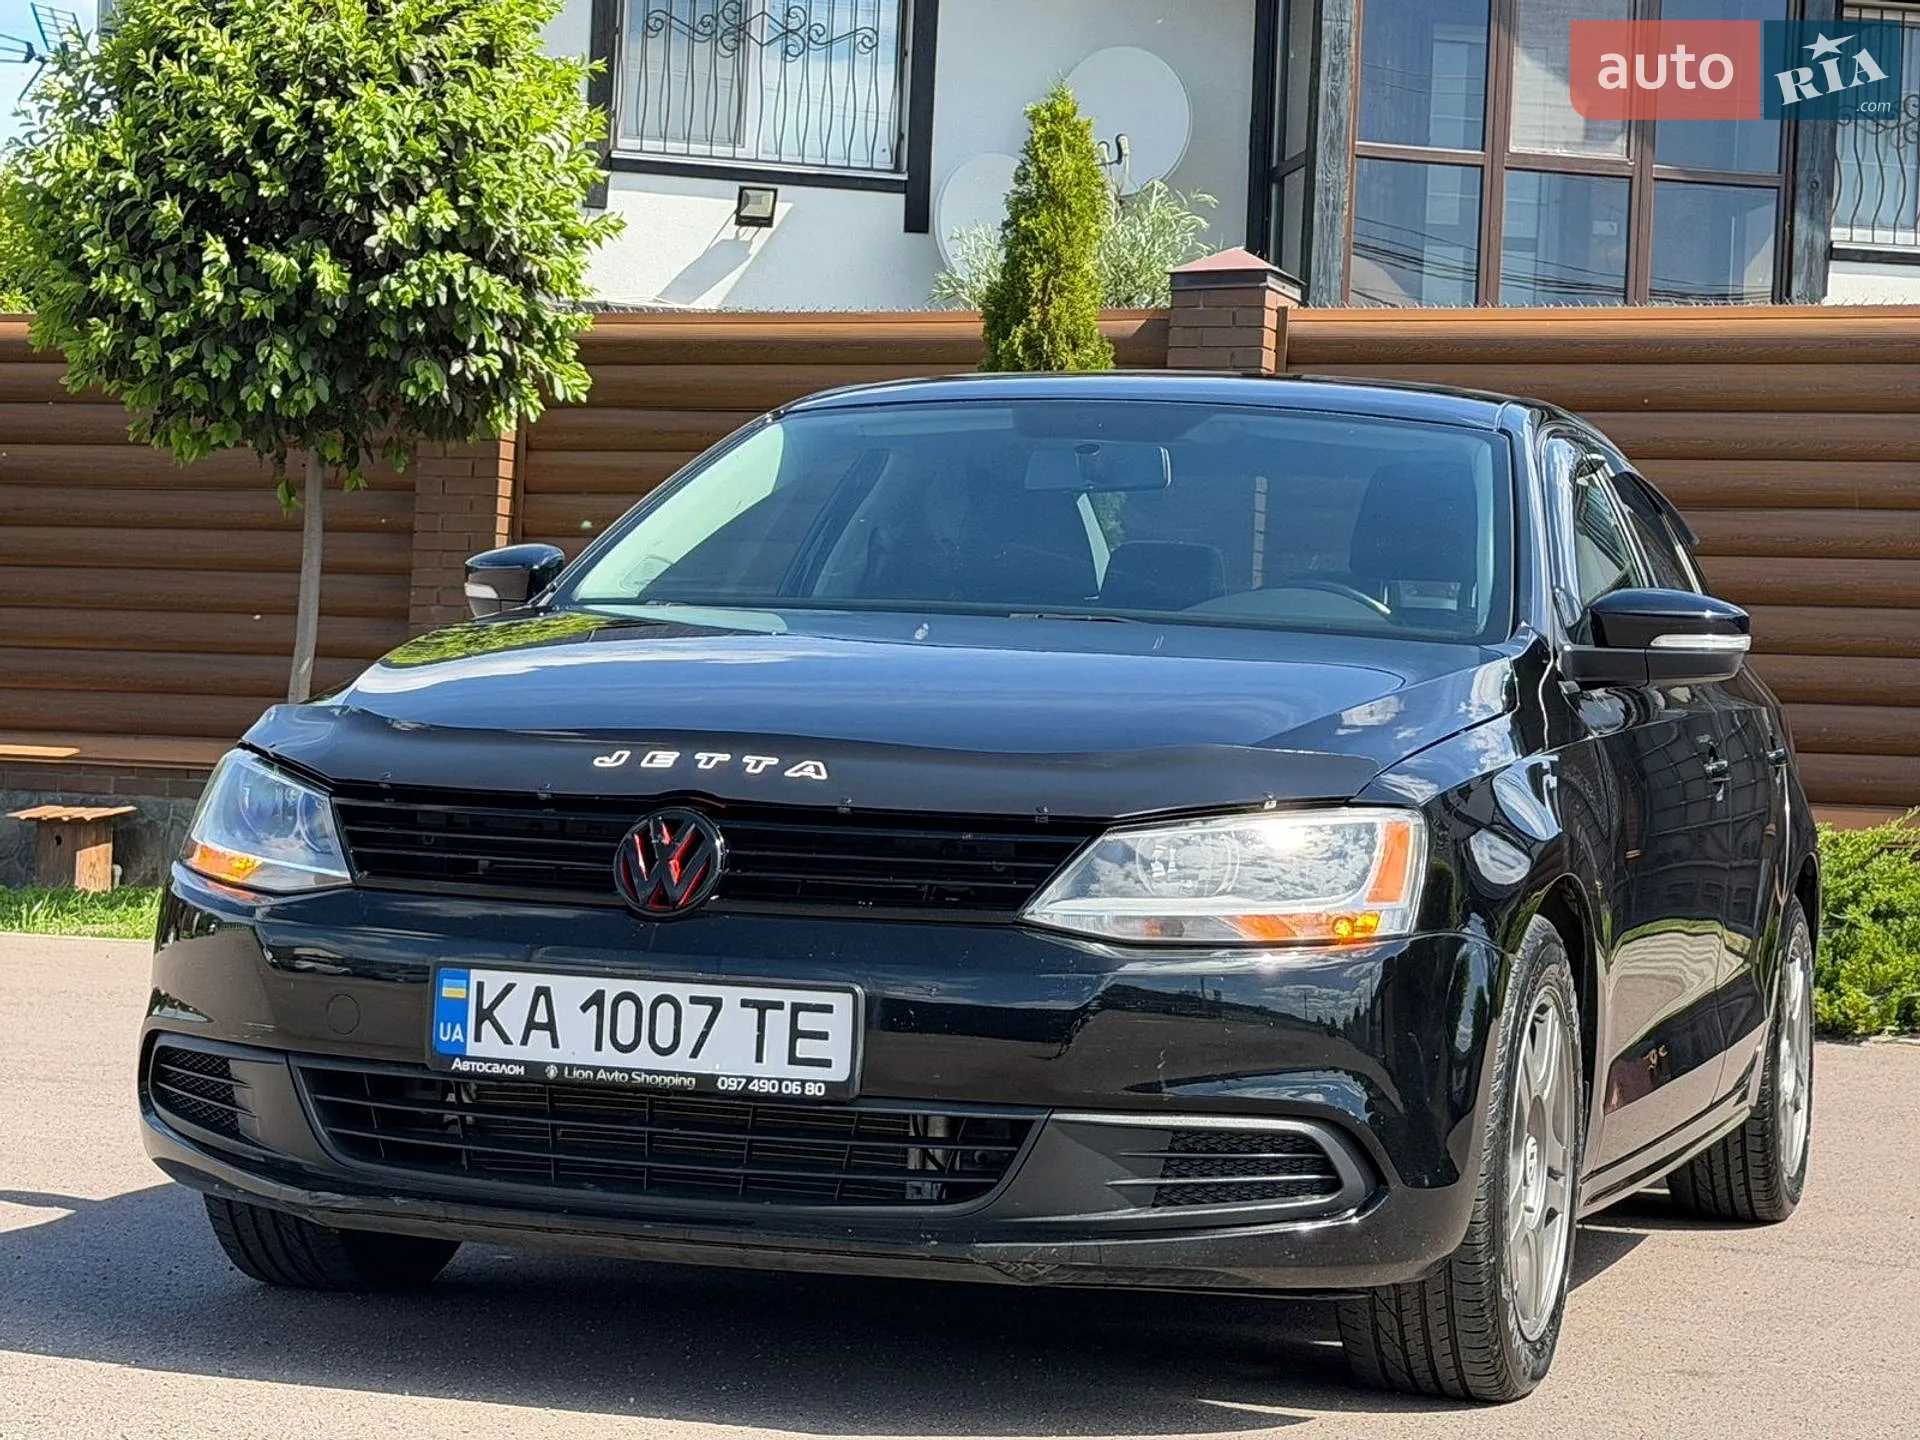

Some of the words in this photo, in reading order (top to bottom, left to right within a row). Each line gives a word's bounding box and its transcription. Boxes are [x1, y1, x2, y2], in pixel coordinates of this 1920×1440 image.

[593, 750, 828, 780] JETTA
[440, 1022, 464, 1043] UA
[474, 980, 560, 1050] KA
[579, 989, 723, 1059] 1007
[740, 998, 833, 1068] TE
[451, 1058, 526, 1076] Автосалон
[564, 1066, 594, 1080] Lion
[596, 1069, 629, 1083] Avto
[631, 1071, 697, 1090] Shopping
[717, 1077, 747, 1091] 097
[748, 1079, 779, 1093] 490
[781, 1081, 802, 1095] 06
[804, 1082, 826, 1096] 80
